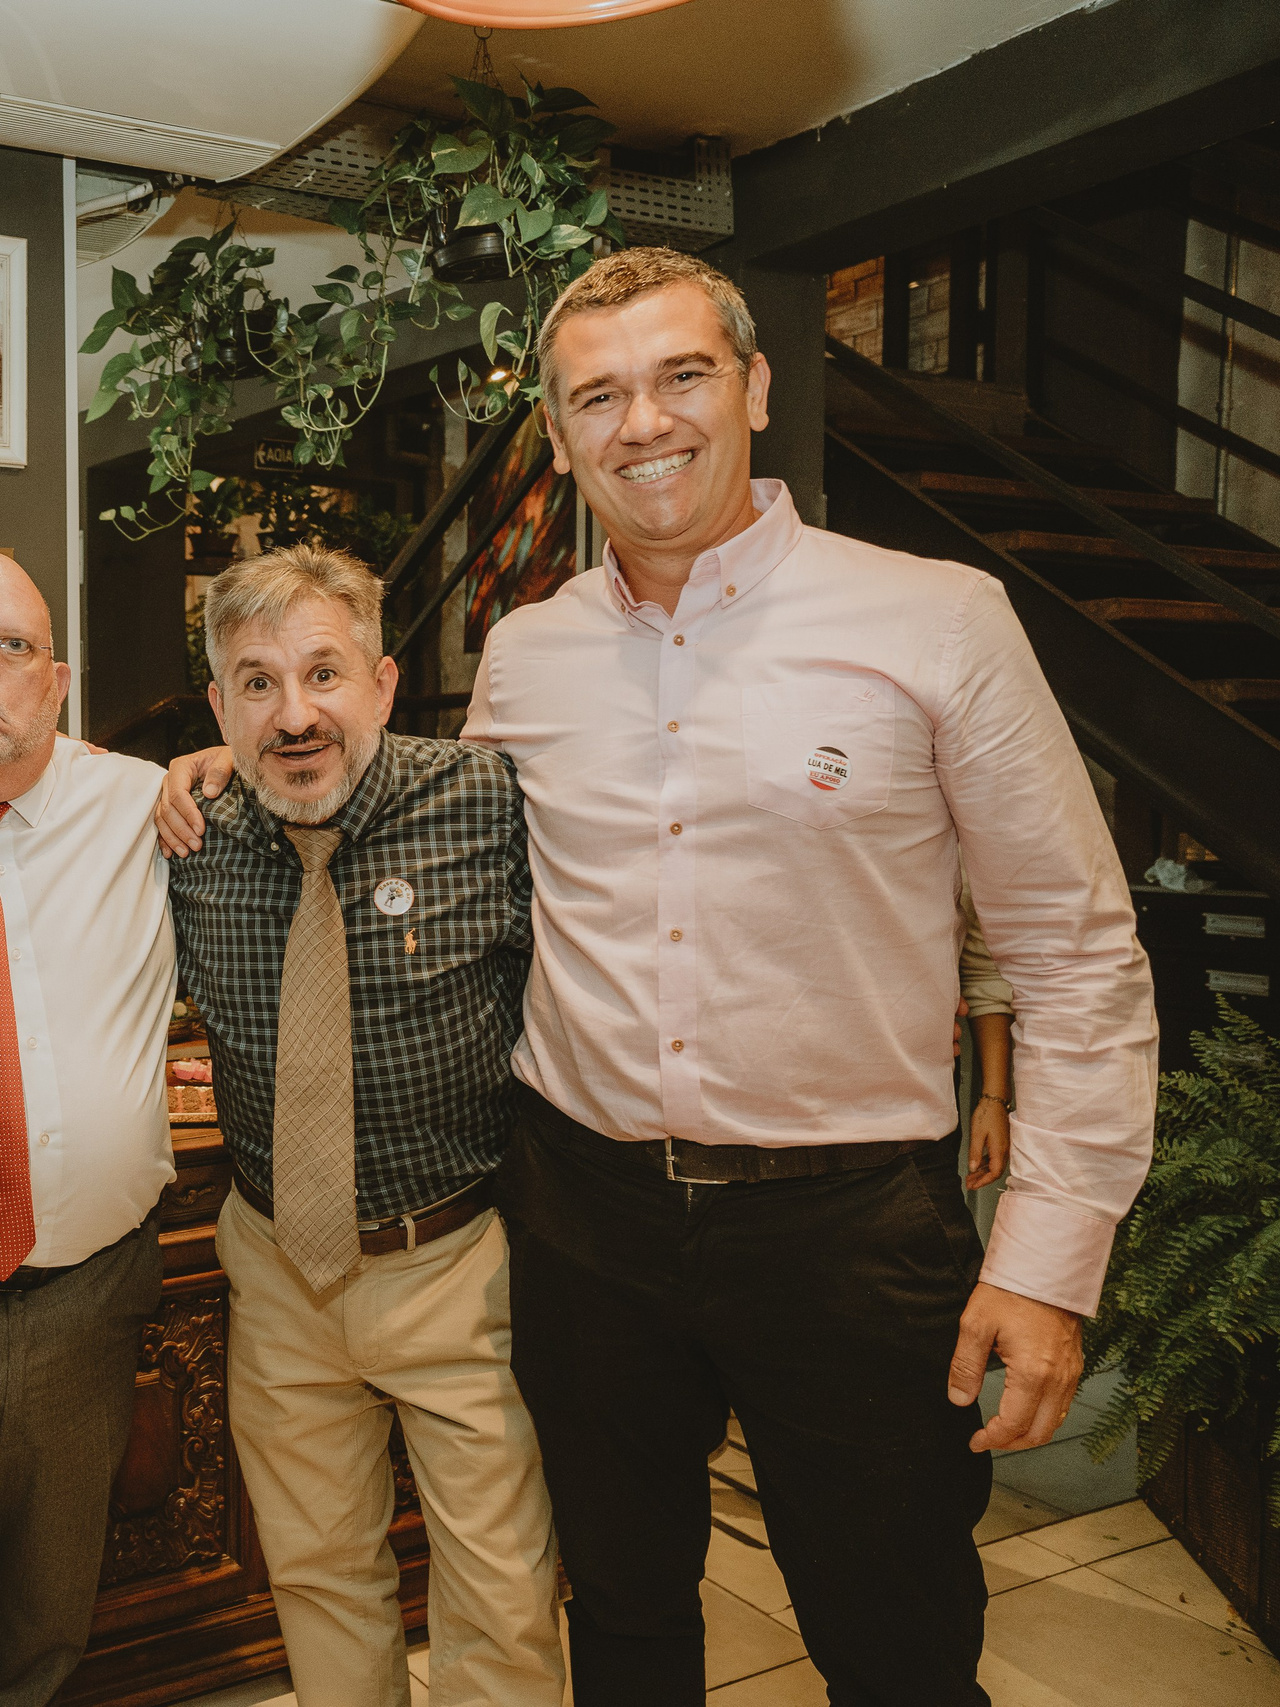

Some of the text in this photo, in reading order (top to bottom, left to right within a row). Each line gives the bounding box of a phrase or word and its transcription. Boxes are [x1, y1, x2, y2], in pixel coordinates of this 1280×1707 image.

[814, 753, 847, 766] OPERAÇÃO
[807, 758, 847, 778] LUA DE MEL
